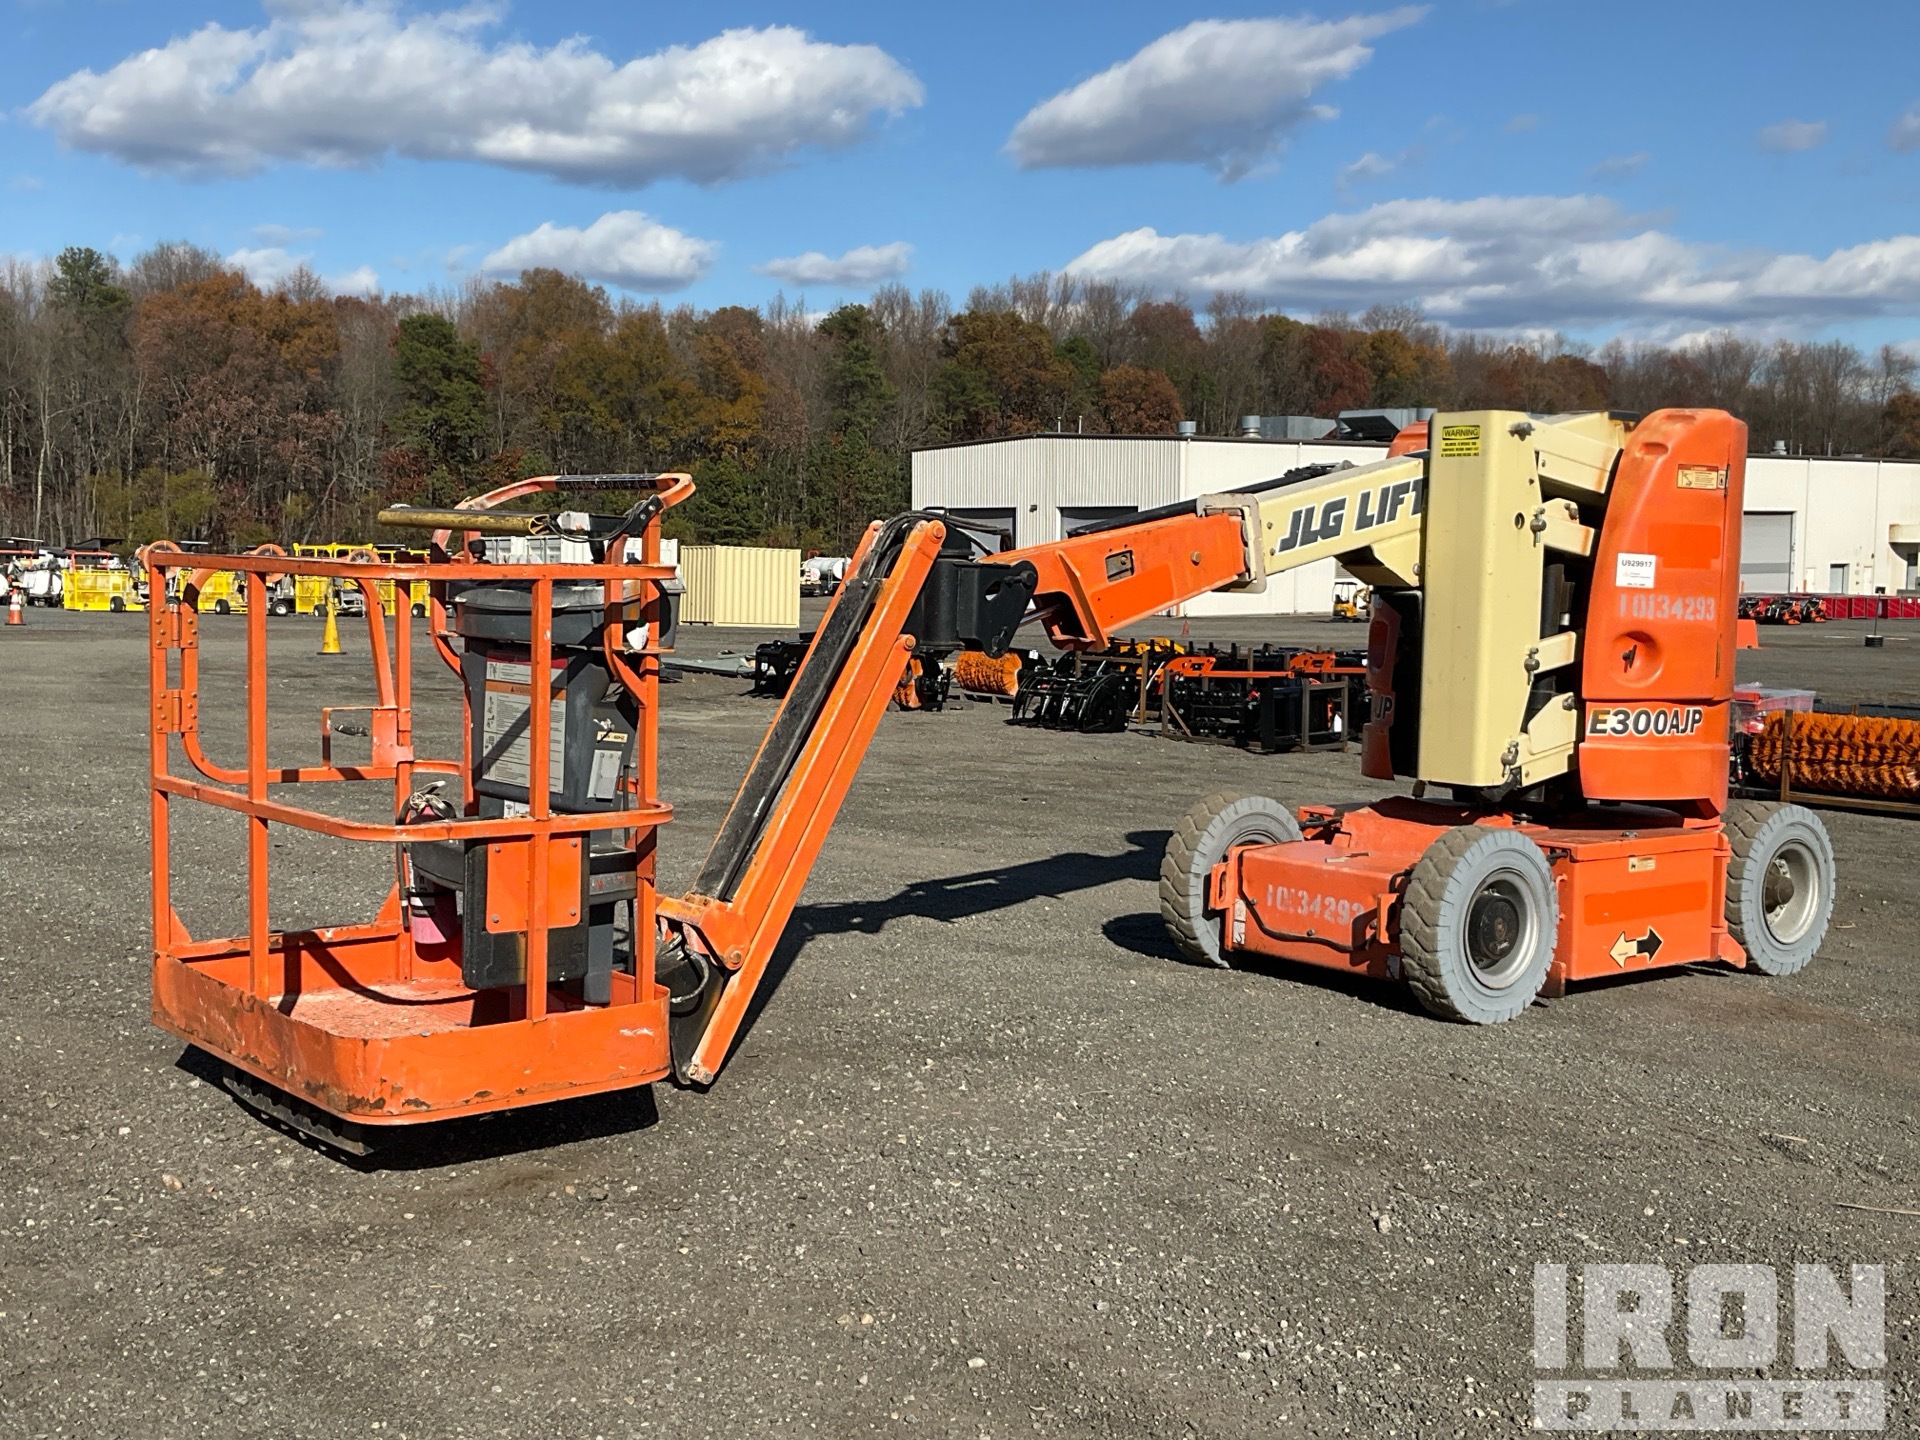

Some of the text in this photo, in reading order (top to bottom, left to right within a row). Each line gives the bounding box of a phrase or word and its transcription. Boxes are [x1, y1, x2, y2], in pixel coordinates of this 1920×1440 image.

[1444, 429, 1479, 437] WARNING
[1277, 477, 1423, 553] JLG LIFT
[1621, 559, 1653, 568] U929917
[1620, 593, 1716, 621] 10134293
[1588, 708, 1703, 735] E300AJP
